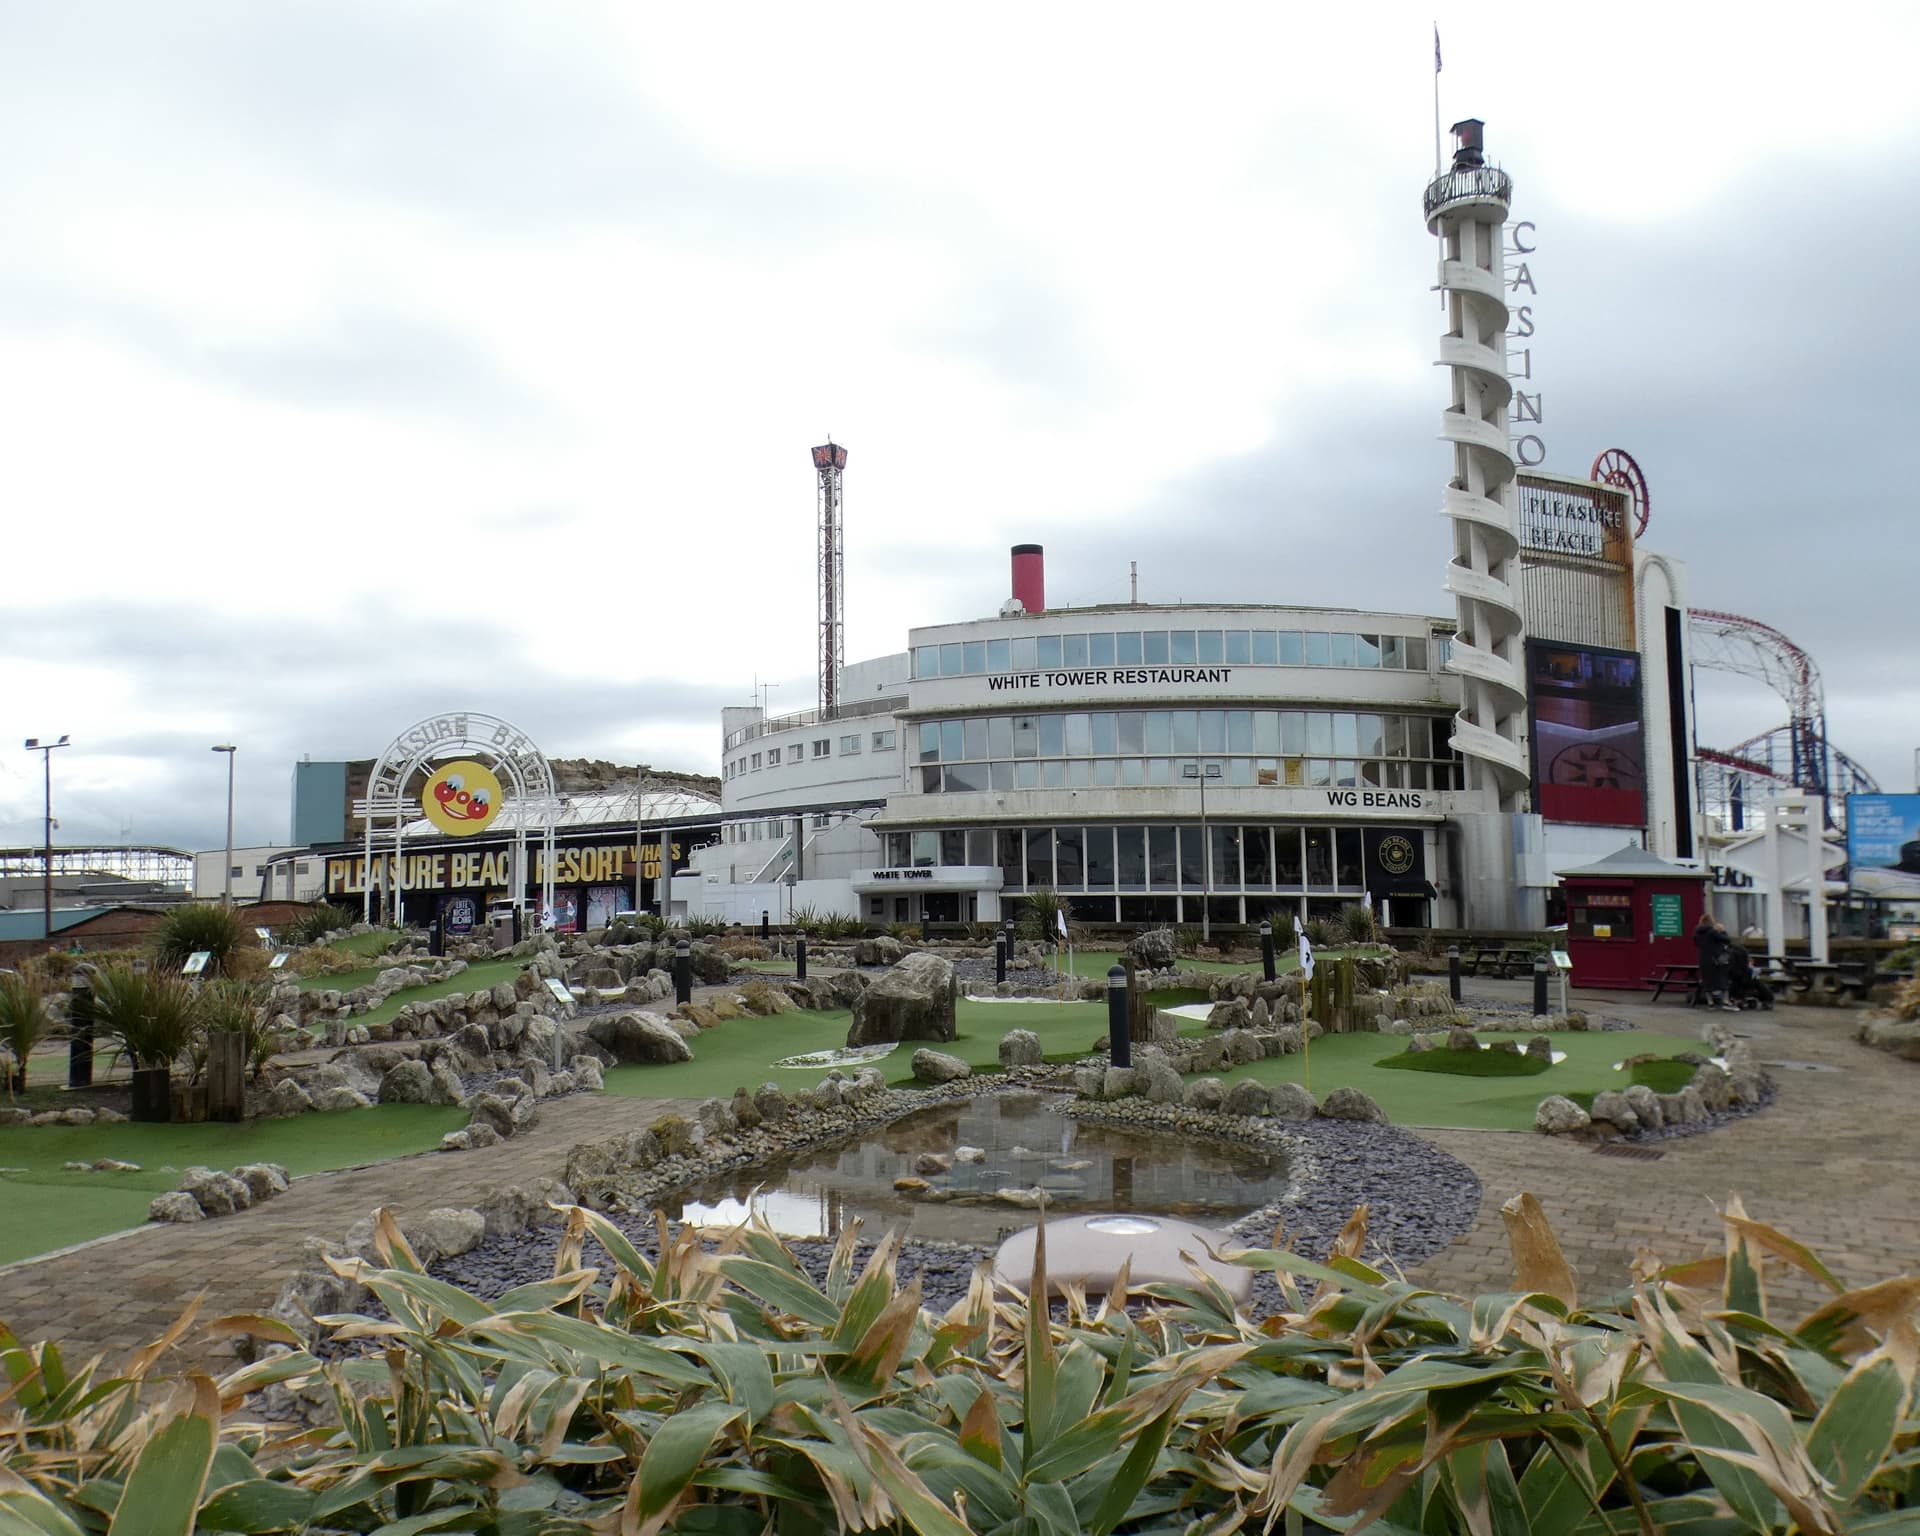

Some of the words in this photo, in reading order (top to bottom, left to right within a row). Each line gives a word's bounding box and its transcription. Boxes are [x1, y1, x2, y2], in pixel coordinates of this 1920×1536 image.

[1512, 221, 1546, 467] CASINO
[1530, 497, 1621, 528] PLEASURE
[1531, 527, 1593, 552] BEACH
[988, 675, 1040, 691] WHITE
[1045, 671, 1108, 687] TOWER
[1113, 669, 1231, 684] RESTAURANT
[373, 716, 468, 799] PLEASURE
[491, 725, 549, 797] BEACH
[1327, 791, 1357, 806] WG
[1363, 792, 1422, 808] BEANS
[328, 854, 445, 894] PLEASURE
[451, 850, 528, 888] BEAC
[535, 845, 628, 884] RESORT
[872, 871, 899, 880] WHITE
[903, 870, 932, 879] TOWER
